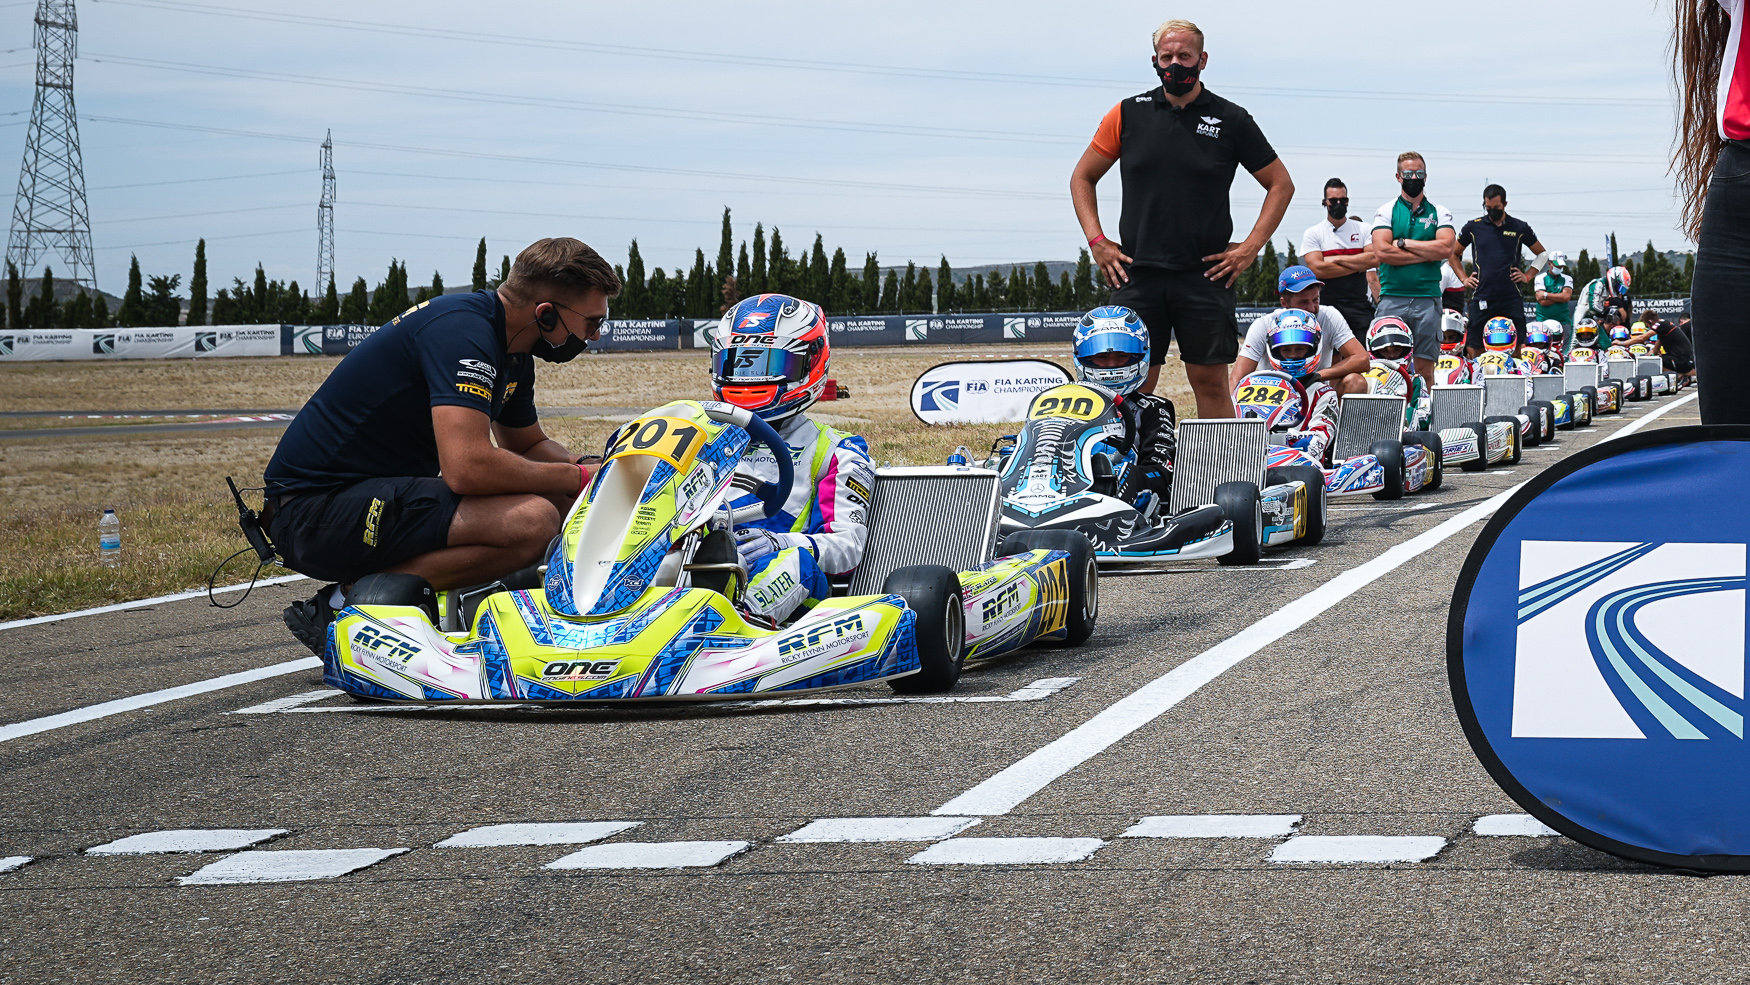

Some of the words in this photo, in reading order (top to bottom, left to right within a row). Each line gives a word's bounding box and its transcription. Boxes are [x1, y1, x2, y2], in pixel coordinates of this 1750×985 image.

[1198, 123, 1221, 133] KART
[1650, 299, 1684, 307] KARTING
[1480, 355, 1503, 366] 227
[1015, 377, 1063, 385] KARTING
[1238, 387, 1286, 405] 284
[1035, 398, 1094, 417] 210
[607, 418, 698, 463] 201
[753, 571, 796, 609] SLATER
[982, 582, 1020, 624] RFM
[354, 625, 421, 664] RFM
[778, 614, 864, 656] RFM
[781, 651, 801, 664] RICKY
[803, 645, 825, 659] FLYNN
[826, 631, 870, 651] MOTORSPORT
[376, 652, 407, 672] MOTORSPORT
[545, 661, 613, 677] ONE
